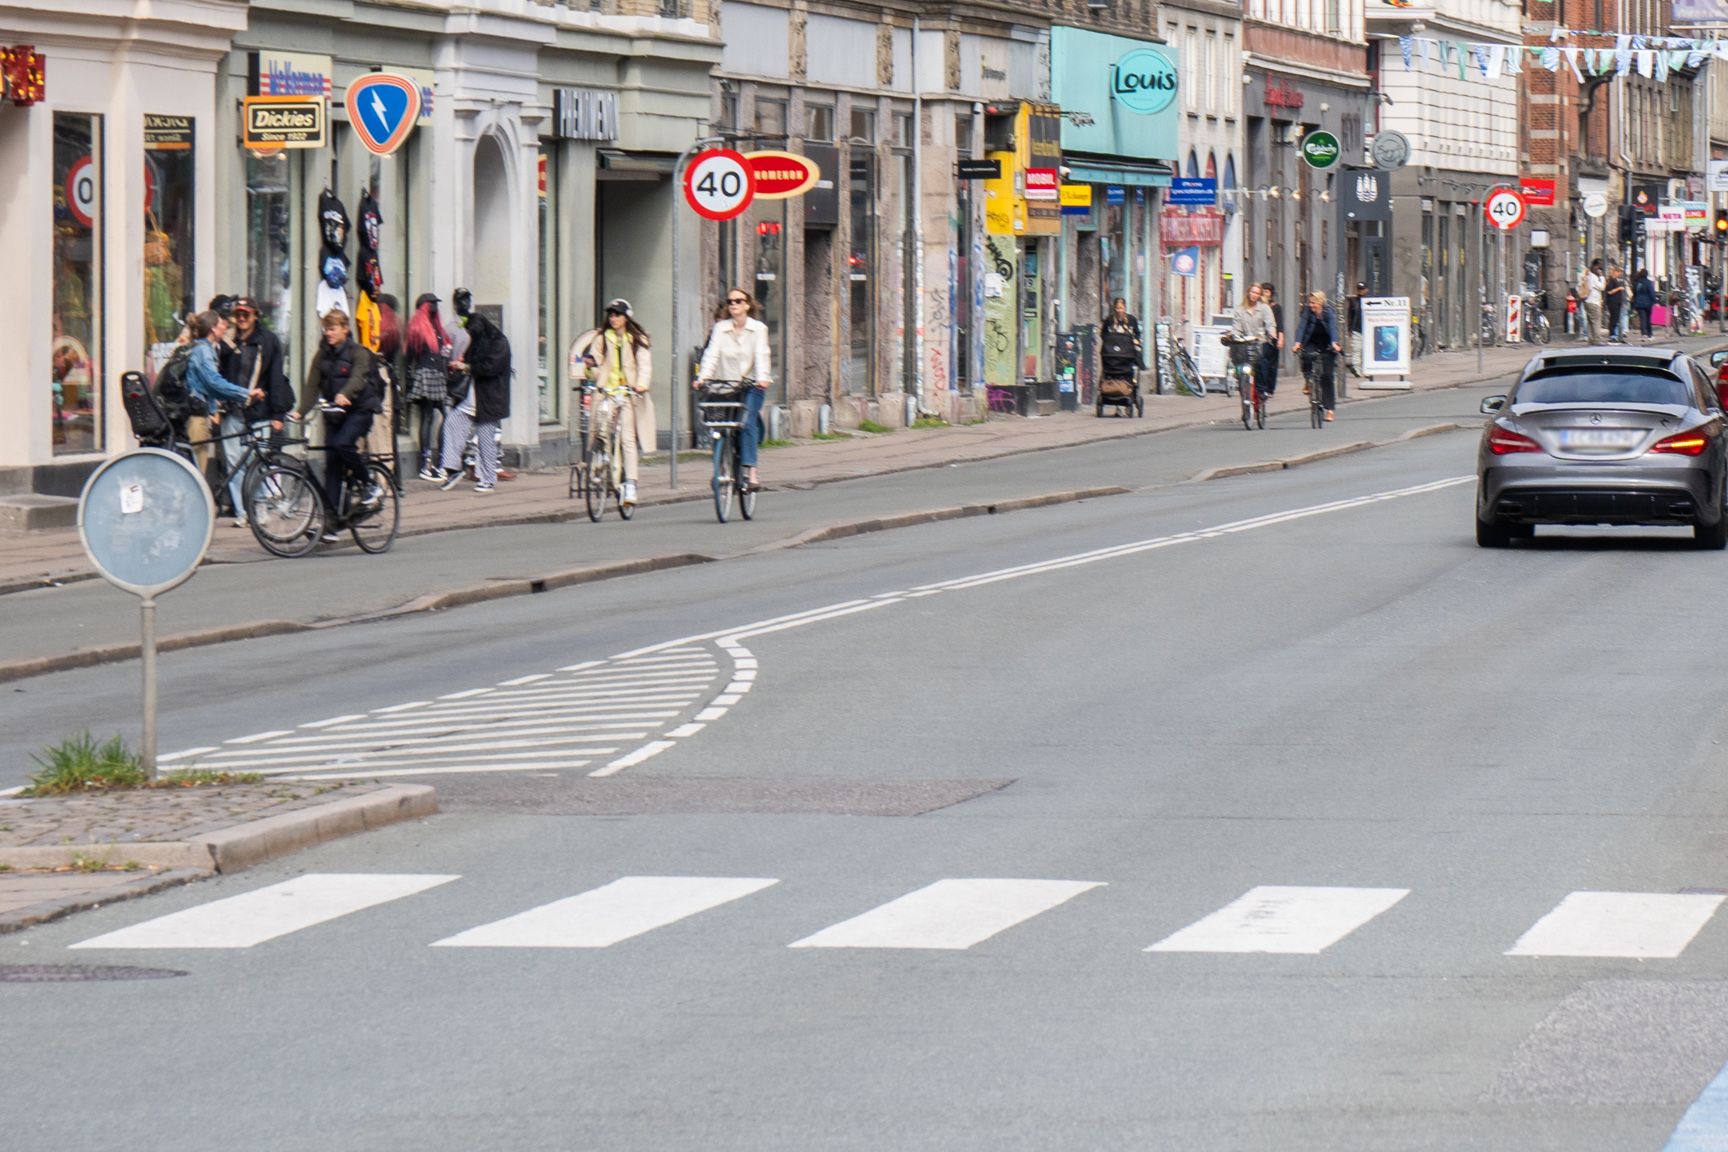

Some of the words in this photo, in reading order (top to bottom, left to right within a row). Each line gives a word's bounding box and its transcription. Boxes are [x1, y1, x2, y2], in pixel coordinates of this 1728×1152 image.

[1115, 66, 1176, 95] Louis
[255, 101, 314, 128] Dickies
[261, 133, 286, 141] Since
[696, 171, 741, 197] 40
[1493, 202, 1516, 215] 40
